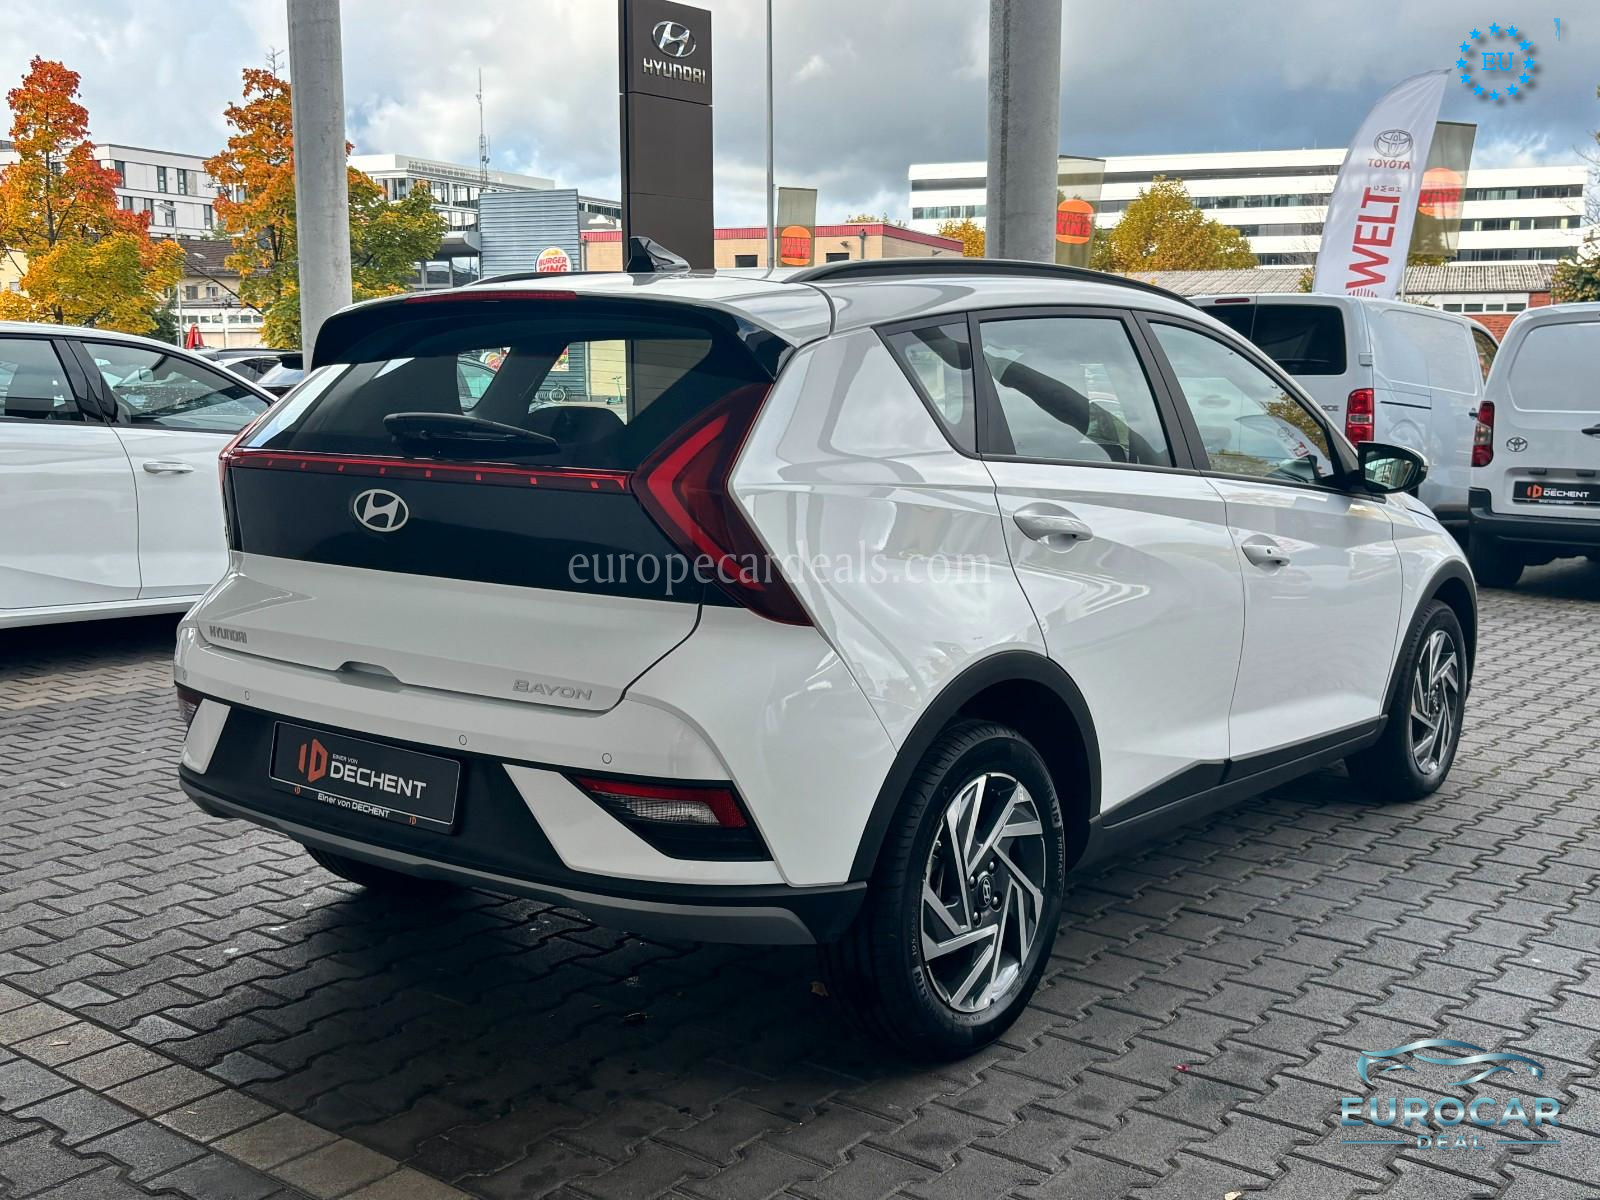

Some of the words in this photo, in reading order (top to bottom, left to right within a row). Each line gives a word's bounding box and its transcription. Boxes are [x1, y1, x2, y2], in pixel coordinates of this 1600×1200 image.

[643, 57, 706, 84] HYUNDAI
[1367, 158, 1411, 170] TOYOTA
[1345, 187, 1401, 289] WELT
[1543, 490, 1590, 498] DECHENT
[209, 625, 248, 644] HYUNDAI
[512, 679, 593, 701] BAYON
[330, 760, 427, 799] DECHENT
[318, 792, 336, 804] Einer
[338, 799, 351, 809] von
[351, 802, 390, 818] DECHENT
